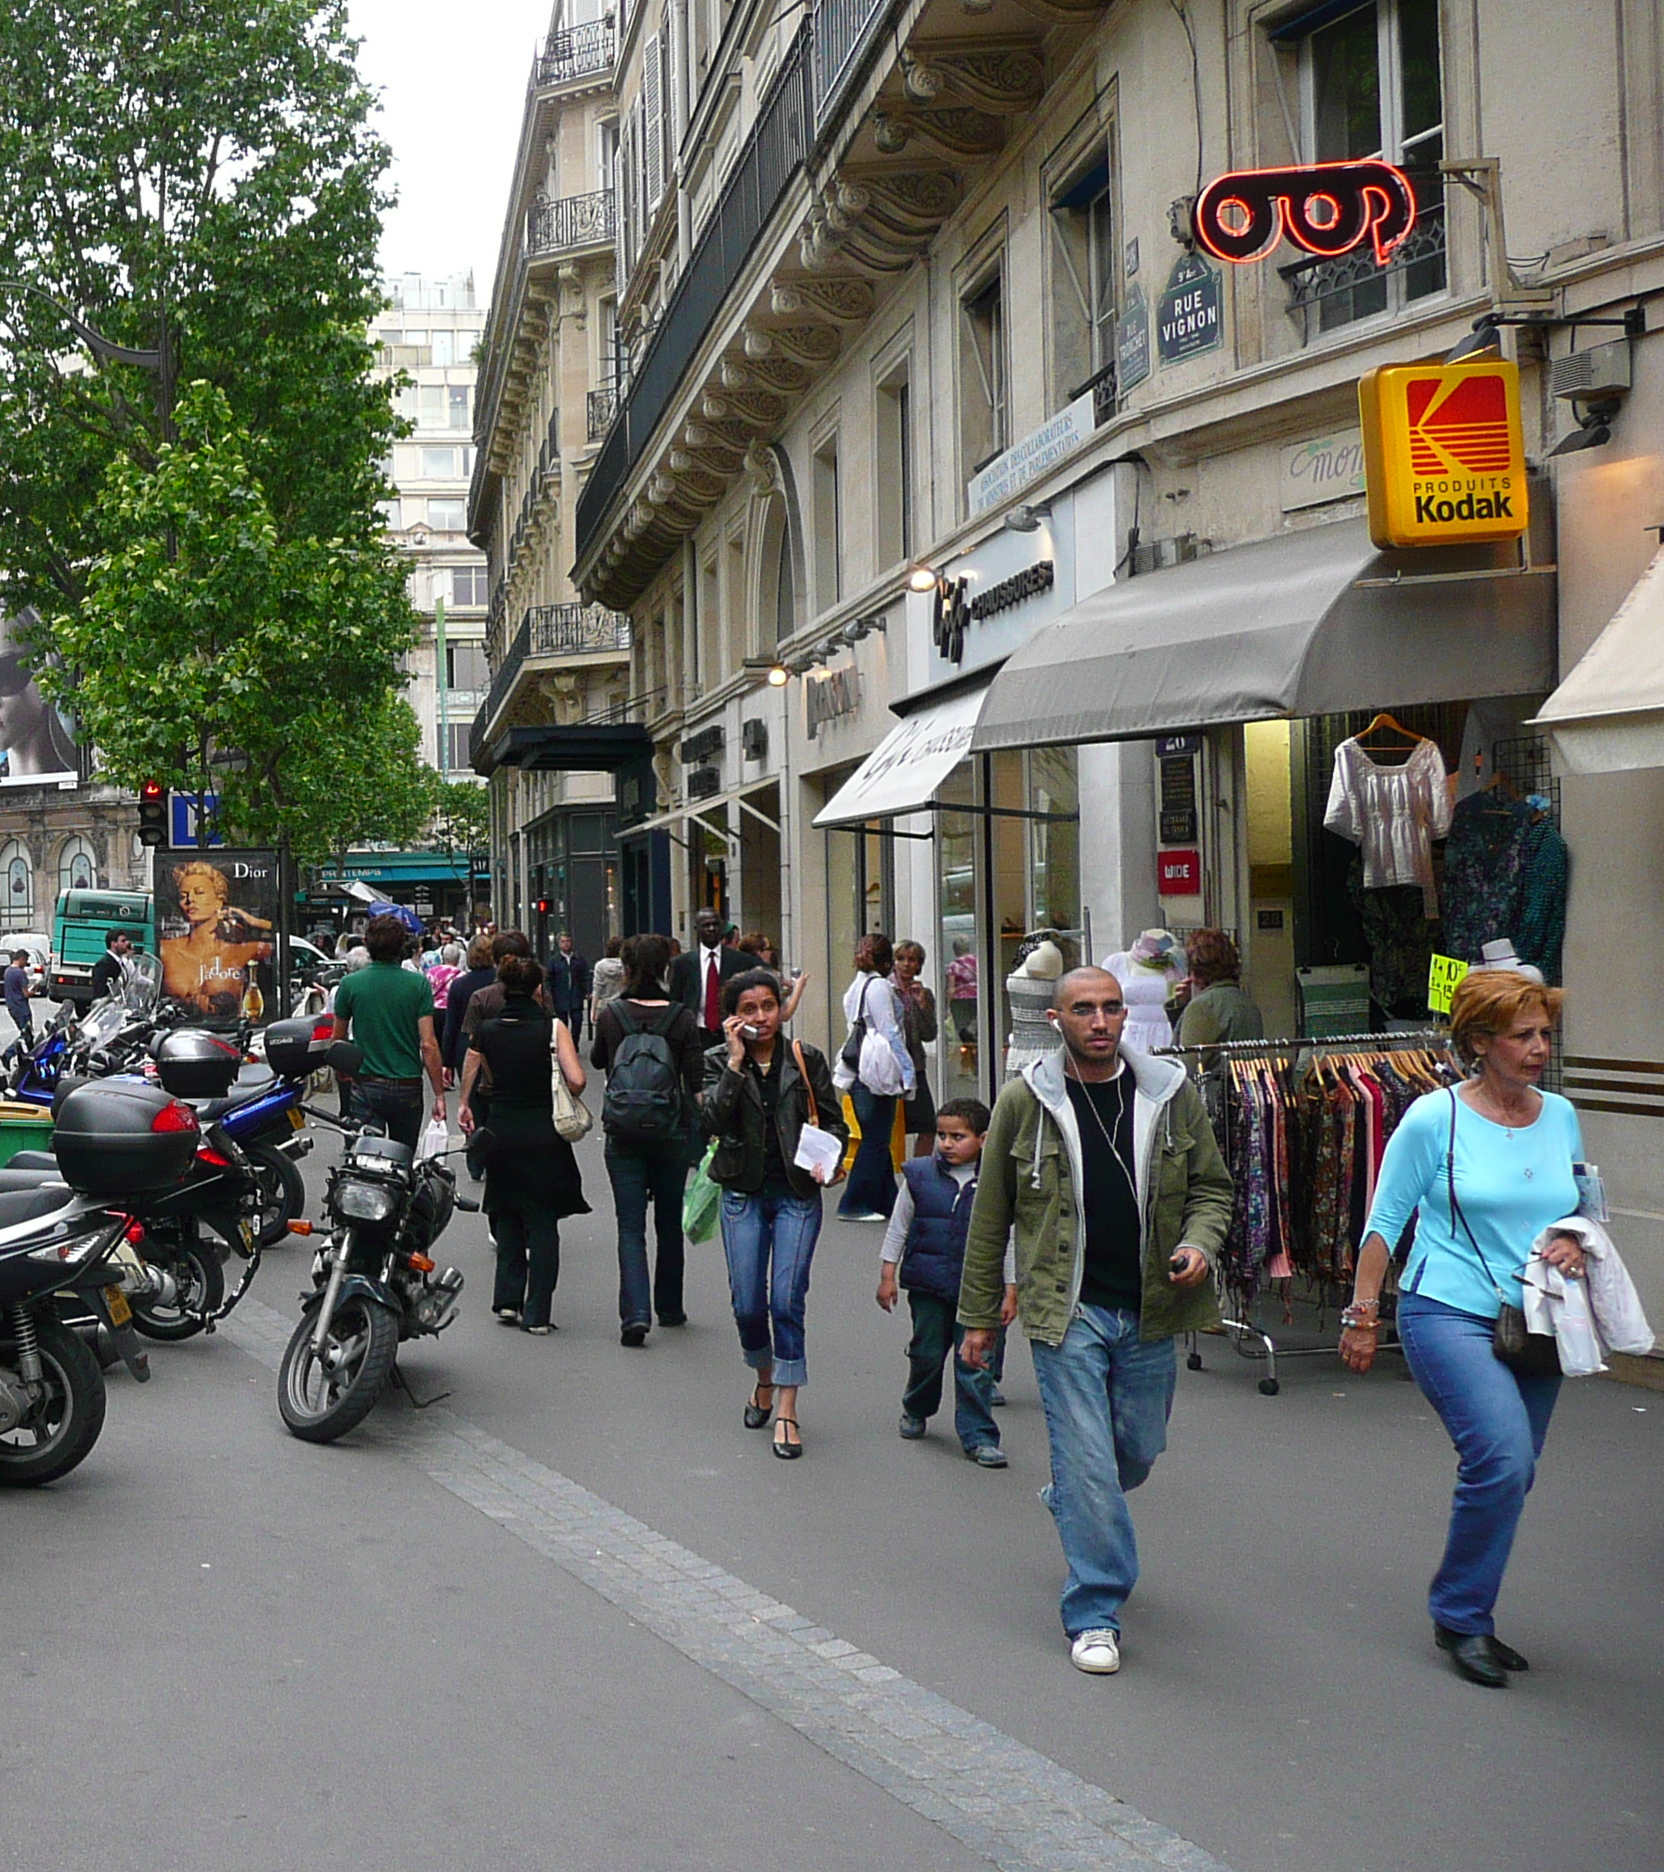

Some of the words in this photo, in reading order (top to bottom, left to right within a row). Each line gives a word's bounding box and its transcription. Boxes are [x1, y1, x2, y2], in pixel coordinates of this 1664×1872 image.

[1174, 290, 1202, 317] RUE
[1162, 305, 1216, 341] VIGNON
[1413, 477, 1511, 494] PRODUITS
[1415, 491, 1514, 524] Kodak
[971, 559, 1054, 623] CHAUSSURES
[234, 862, 268, 879] Dior
[1164, 864, 1190, 879] WIDE
